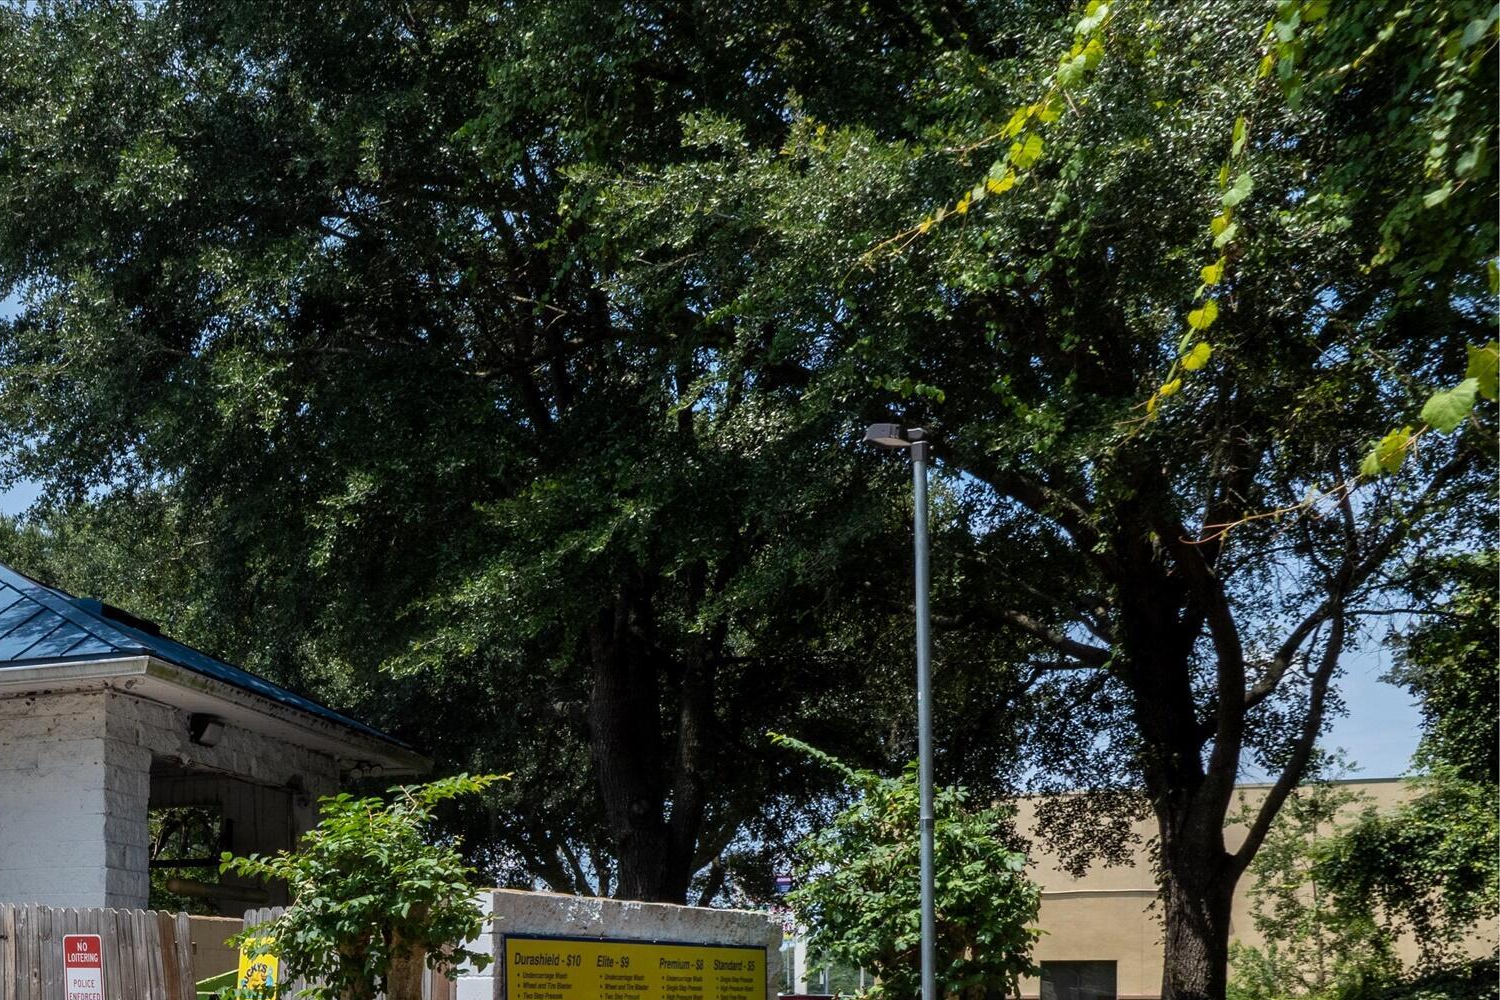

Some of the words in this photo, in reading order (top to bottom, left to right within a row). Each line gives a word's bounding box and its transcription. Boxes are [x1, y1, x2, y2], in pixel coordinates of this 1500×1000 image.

[77, 942, 88, 951] NO
[68, 953, 98, 962] LOITERING
[514, 952, 560, 966] Durashield
[566, 954, 581, 966] $10
[596, 955, 613, 967] Elite
[620, 956, 629, 968] $9
[660, 958, 690, 969] Premium
[713, 960, 742, 970] Standard
[73, 979, 95, 988] POLICE
[70, 992, 100, 1000] ENFORCED
